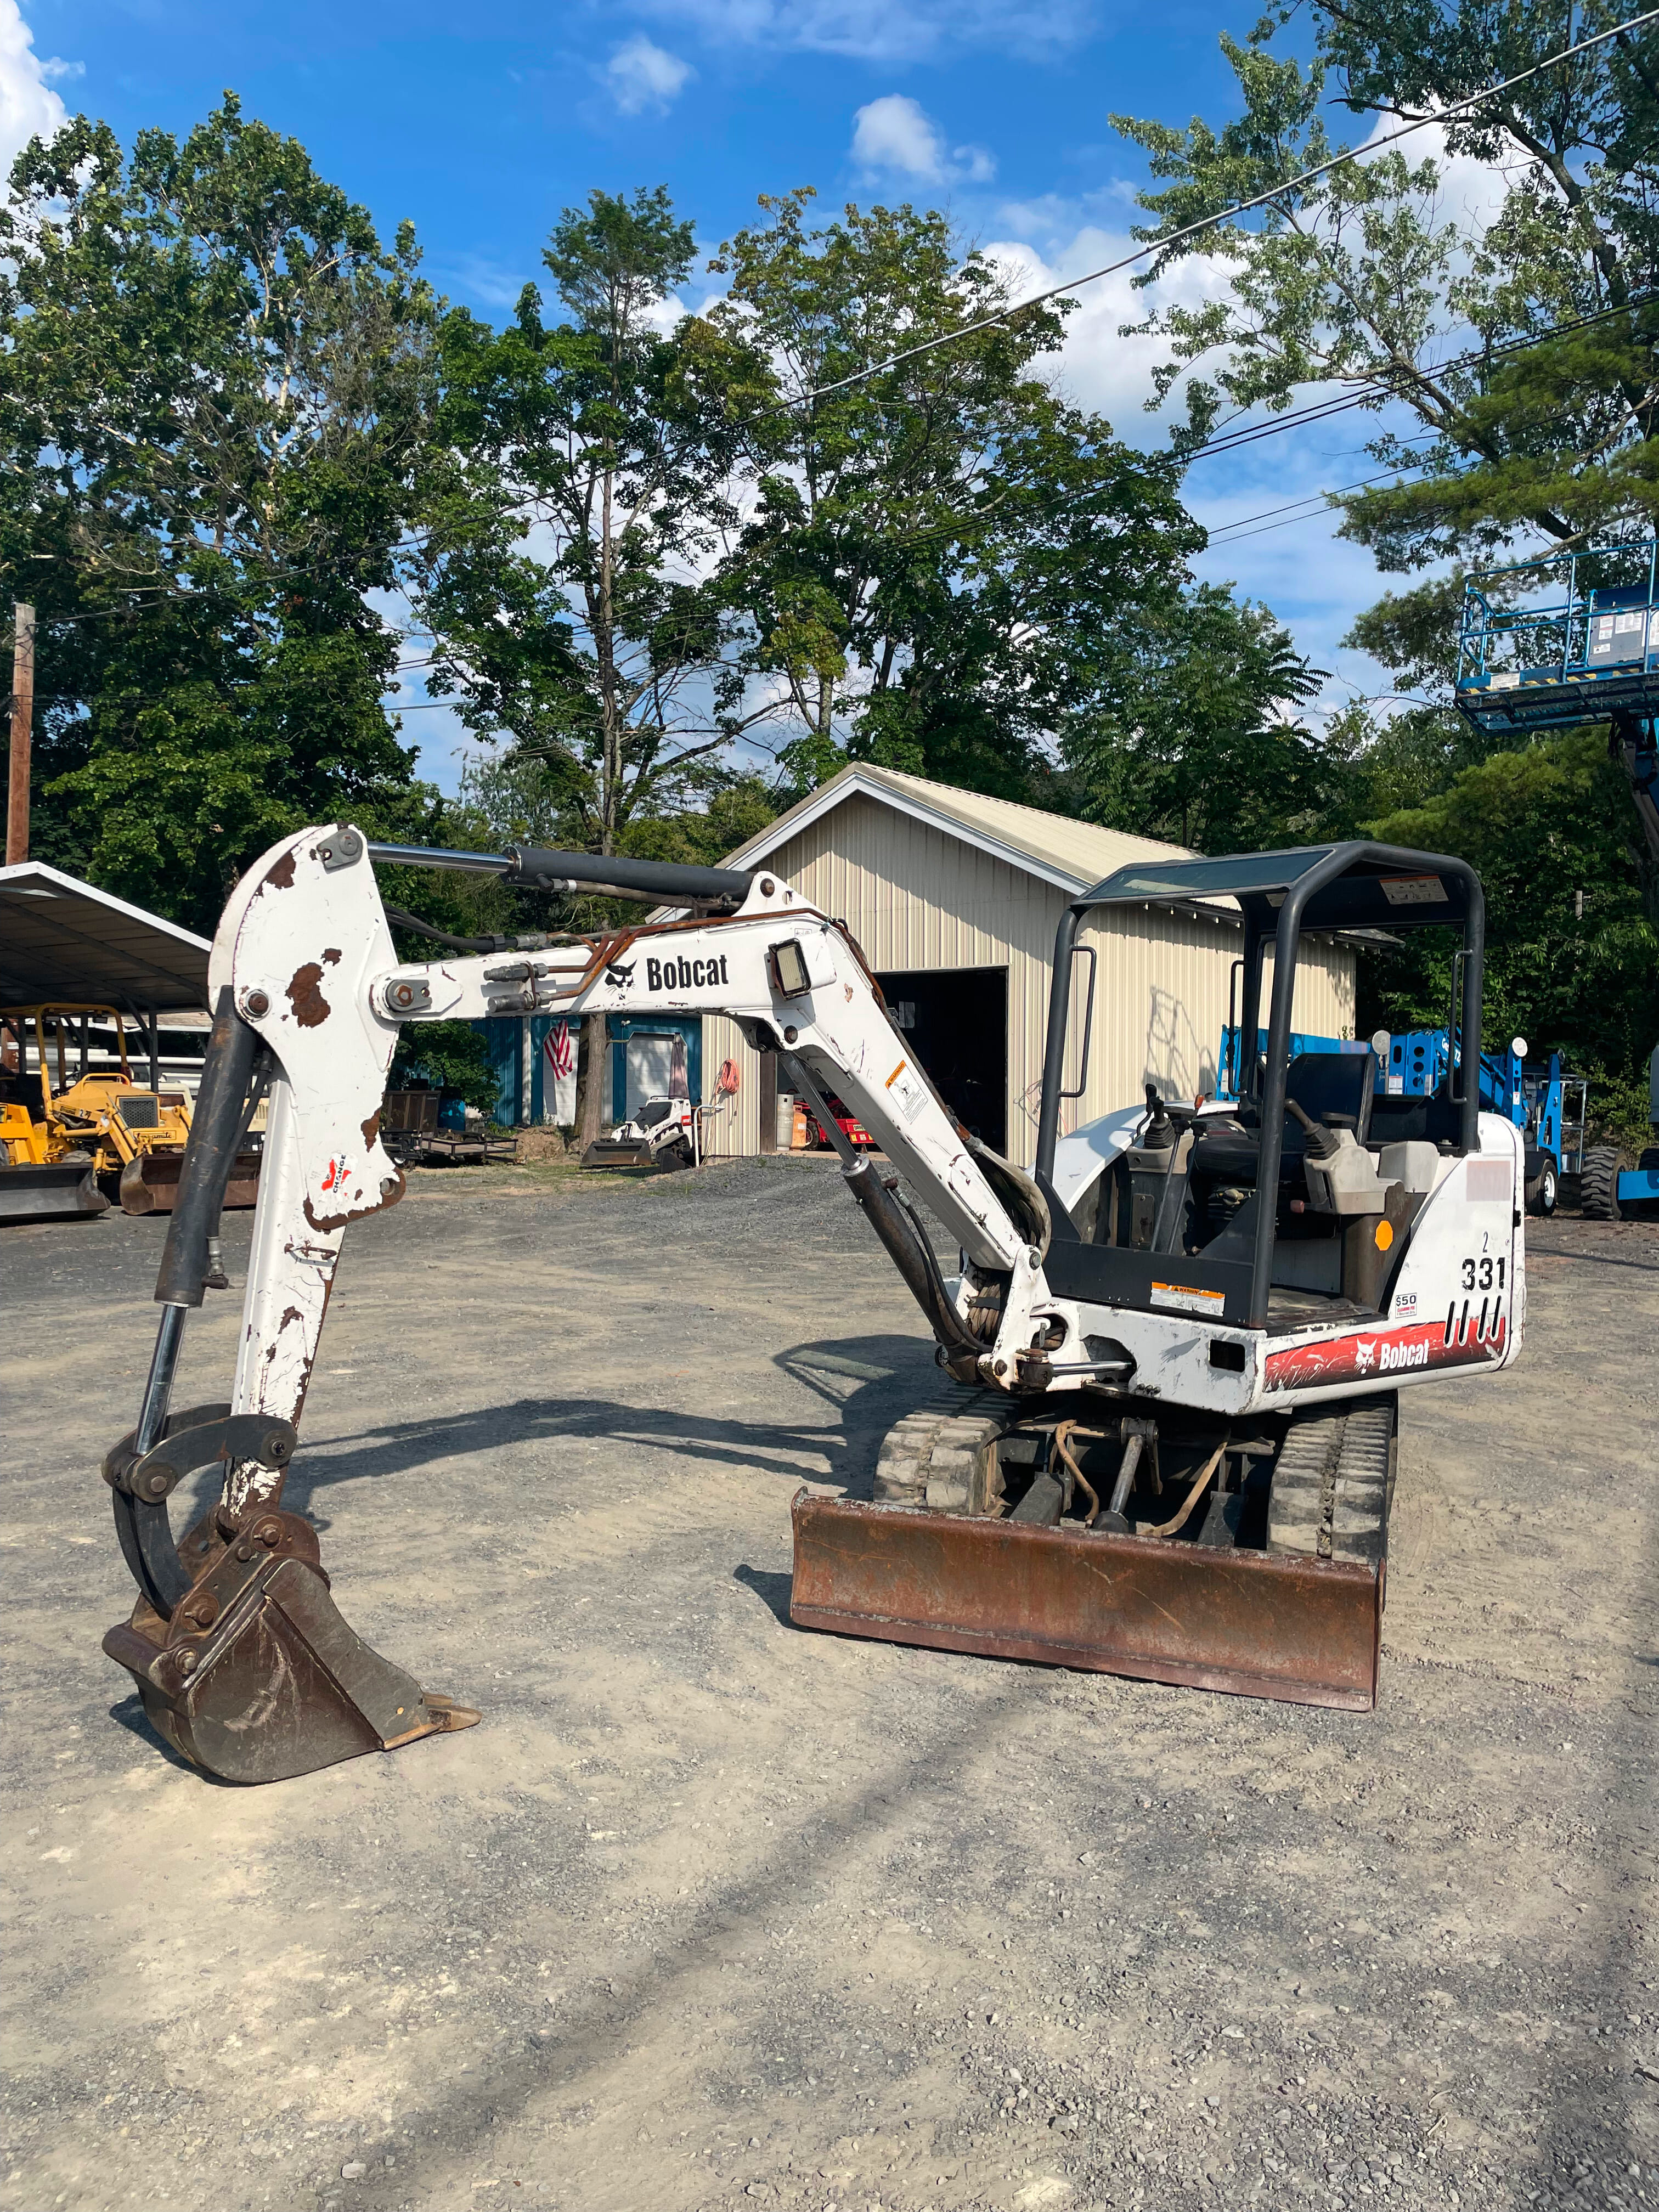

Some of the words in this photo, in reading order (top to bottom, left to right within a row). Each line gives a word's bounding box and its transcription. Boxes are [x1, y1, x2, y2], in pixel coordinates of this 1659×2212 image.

[647, 955, 729, 991] Bobcat
[889, 1063, 905, 1082] WARNING
[1482, 1231, 1488, 1253] 2
[1461, 1257, 1505, 1291] 331
[1180, 1287, 1201, 1295] WARNING
[1396, 1295, 1417, 1307] $50
[1379, 1339, 1430, 1370] Bobcat
